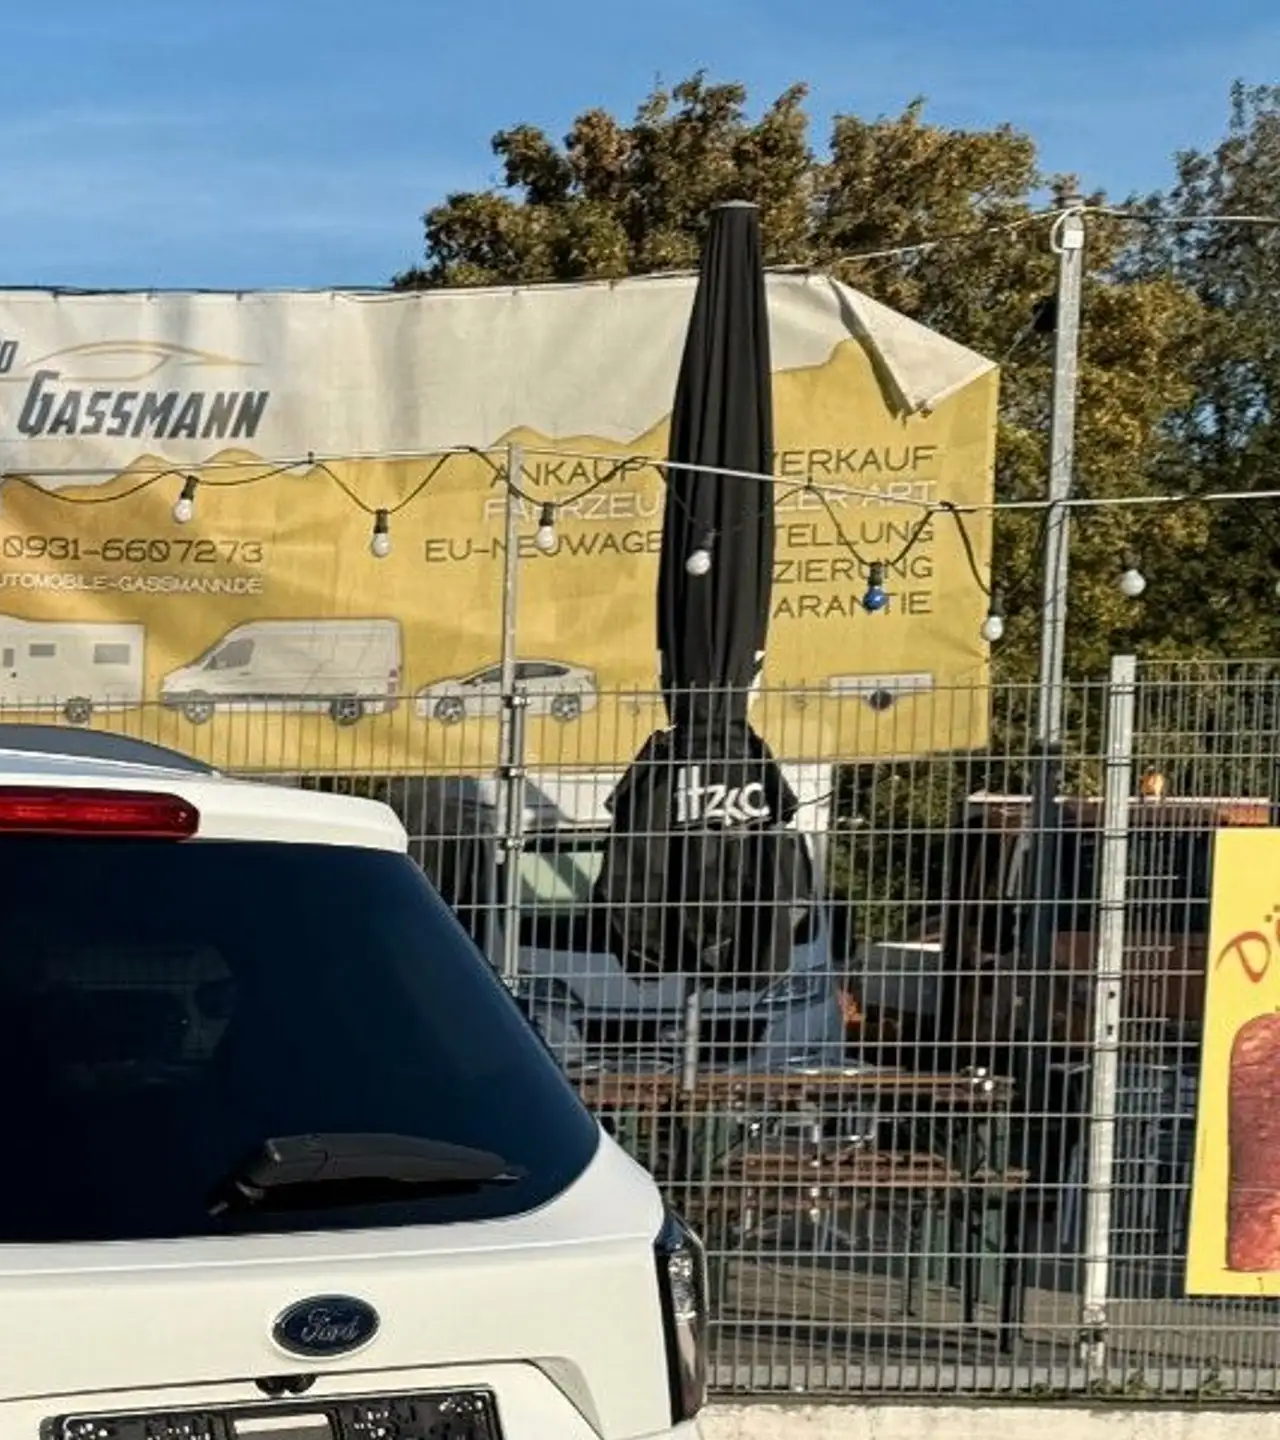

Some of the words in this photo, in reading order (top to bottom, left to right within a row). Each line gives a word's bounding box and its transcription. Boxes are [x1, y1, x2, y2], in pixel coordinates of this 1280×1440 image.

[490, 456, 648, 489] ANKAUF
[774, 444, 938, 477] ERKAUF
[2, 535, 264, 564] 0931-6607273
[300, 1307, 361, 1343] Ford
